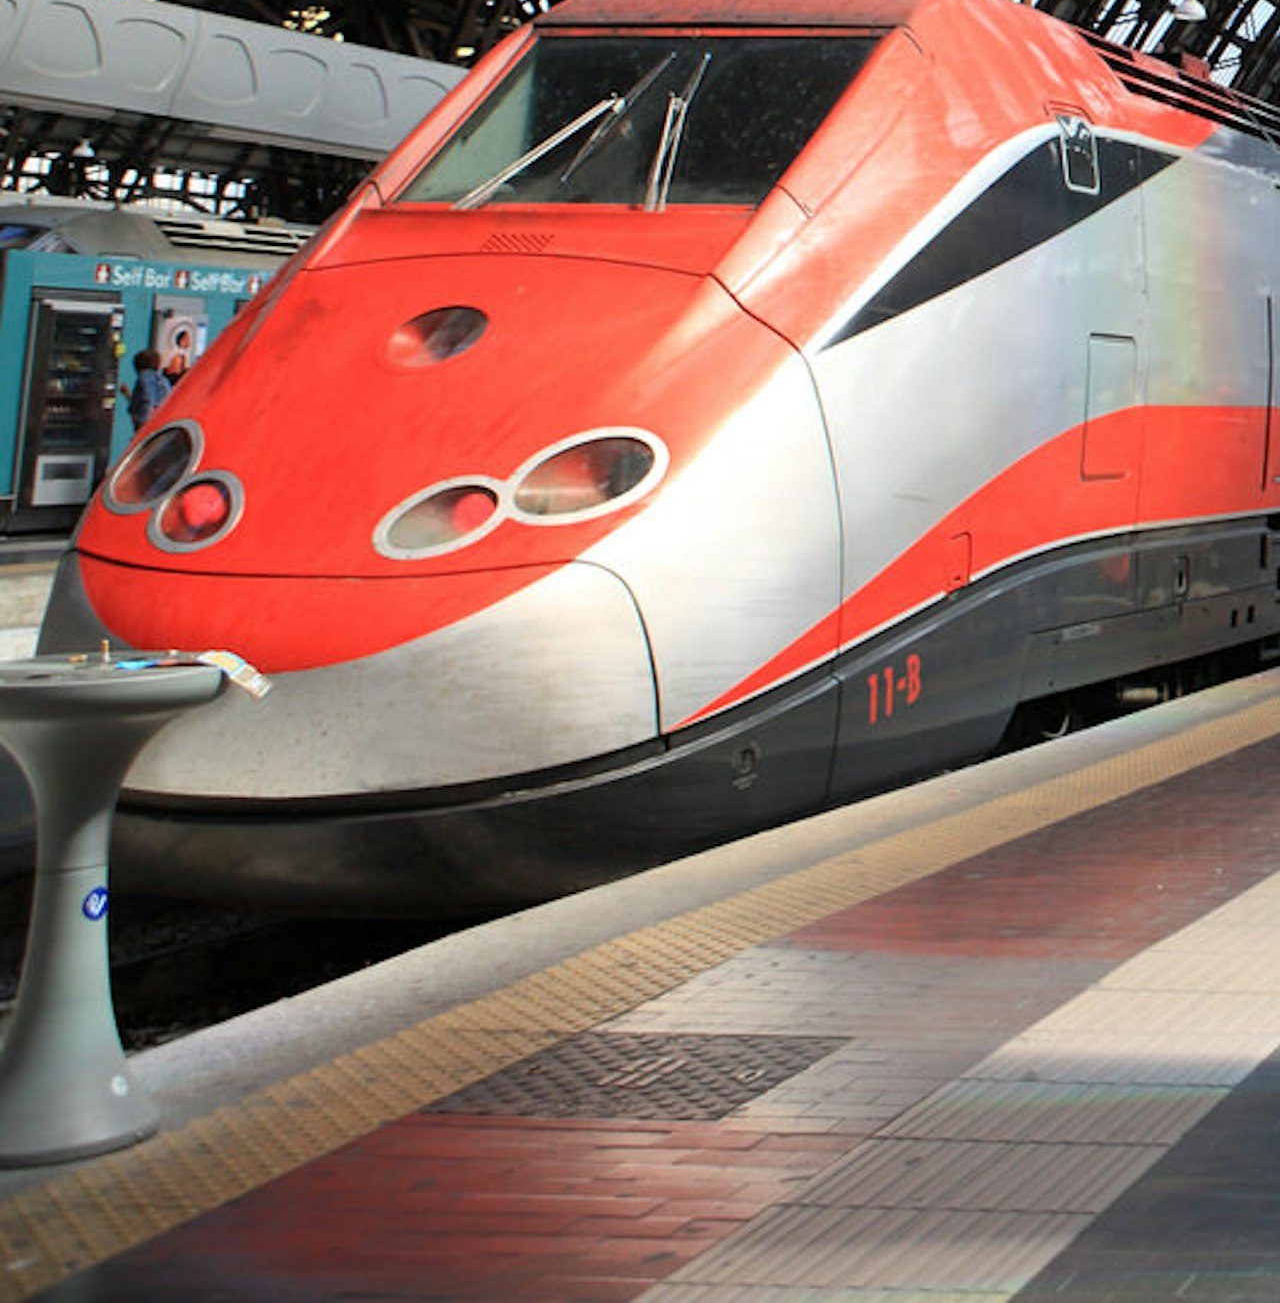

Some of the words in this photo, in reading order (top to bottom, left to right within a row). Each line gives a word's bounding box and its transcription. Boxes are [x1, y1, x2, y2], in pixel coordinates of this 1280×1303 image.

[112, 265, 142, 286] Self
[145, 269, 171, 288] Bar
[190, 271, 217, 291] Self
[220, 273, 245, 294] Bar
